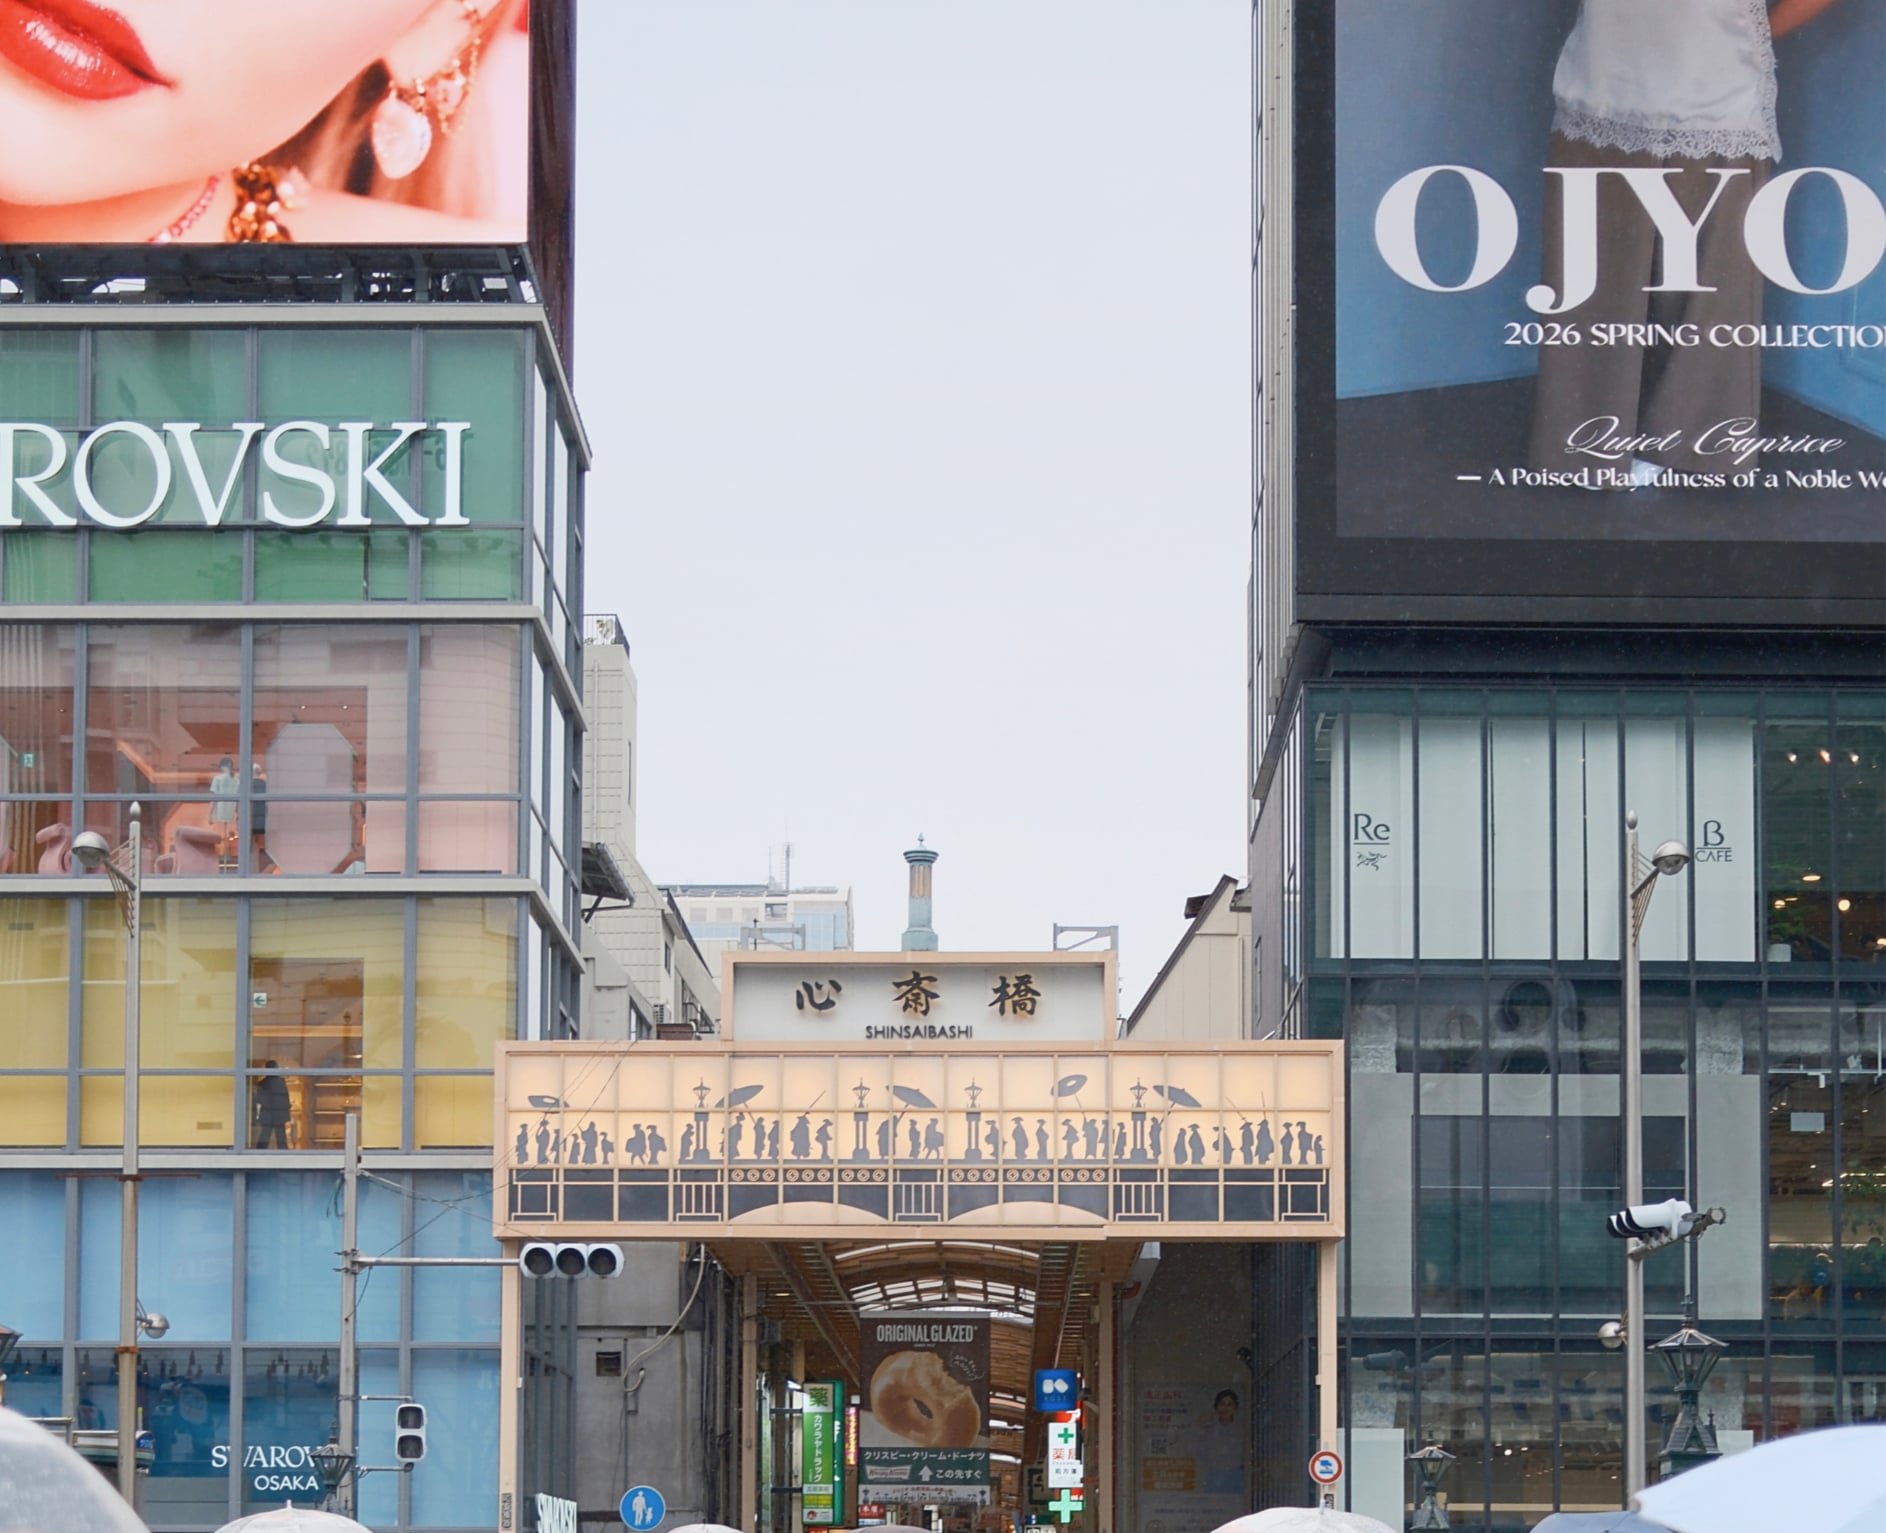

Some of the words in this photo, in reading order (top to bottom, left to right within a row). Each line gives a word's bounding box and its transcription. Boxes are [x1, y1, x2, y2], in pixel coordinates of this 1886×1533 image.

[1375, 165, 1886, 314] OJYO
[1504, 322, 1581, 346] 2026
[1590, 323, 1700, 347] SPRING
[1709, 324, 1886, 348] COLLECTIO
[1564, 416, 1682, 460] Quiet
[1694, 417, 1848, 465] Caprice
[1488, 469, 1505, 486] A
[1512, 469, 1590, 487] Poised
[1597, 469, 1727, 492] Playfulness
[1733, 469, 1760, 487] of
[1765, 474, 1779, 487] a
[1786, 469, 1853, 489] Noble
[1354, 813, 1391, 841] Re
[1695, 850, 1733, 862] CAFE
[796, 970, 1042, 1017] 心斎橋
[865, 1026, 973, 1040] SHINSAIBASHI
[876, 1324, 930, 1343] ORIGINAL
[809, 1387, 829, 1407] 薬
[254, 1475, 319, 1491] OSAKA
[935, 1469, 983, 1479] この先すぐ
